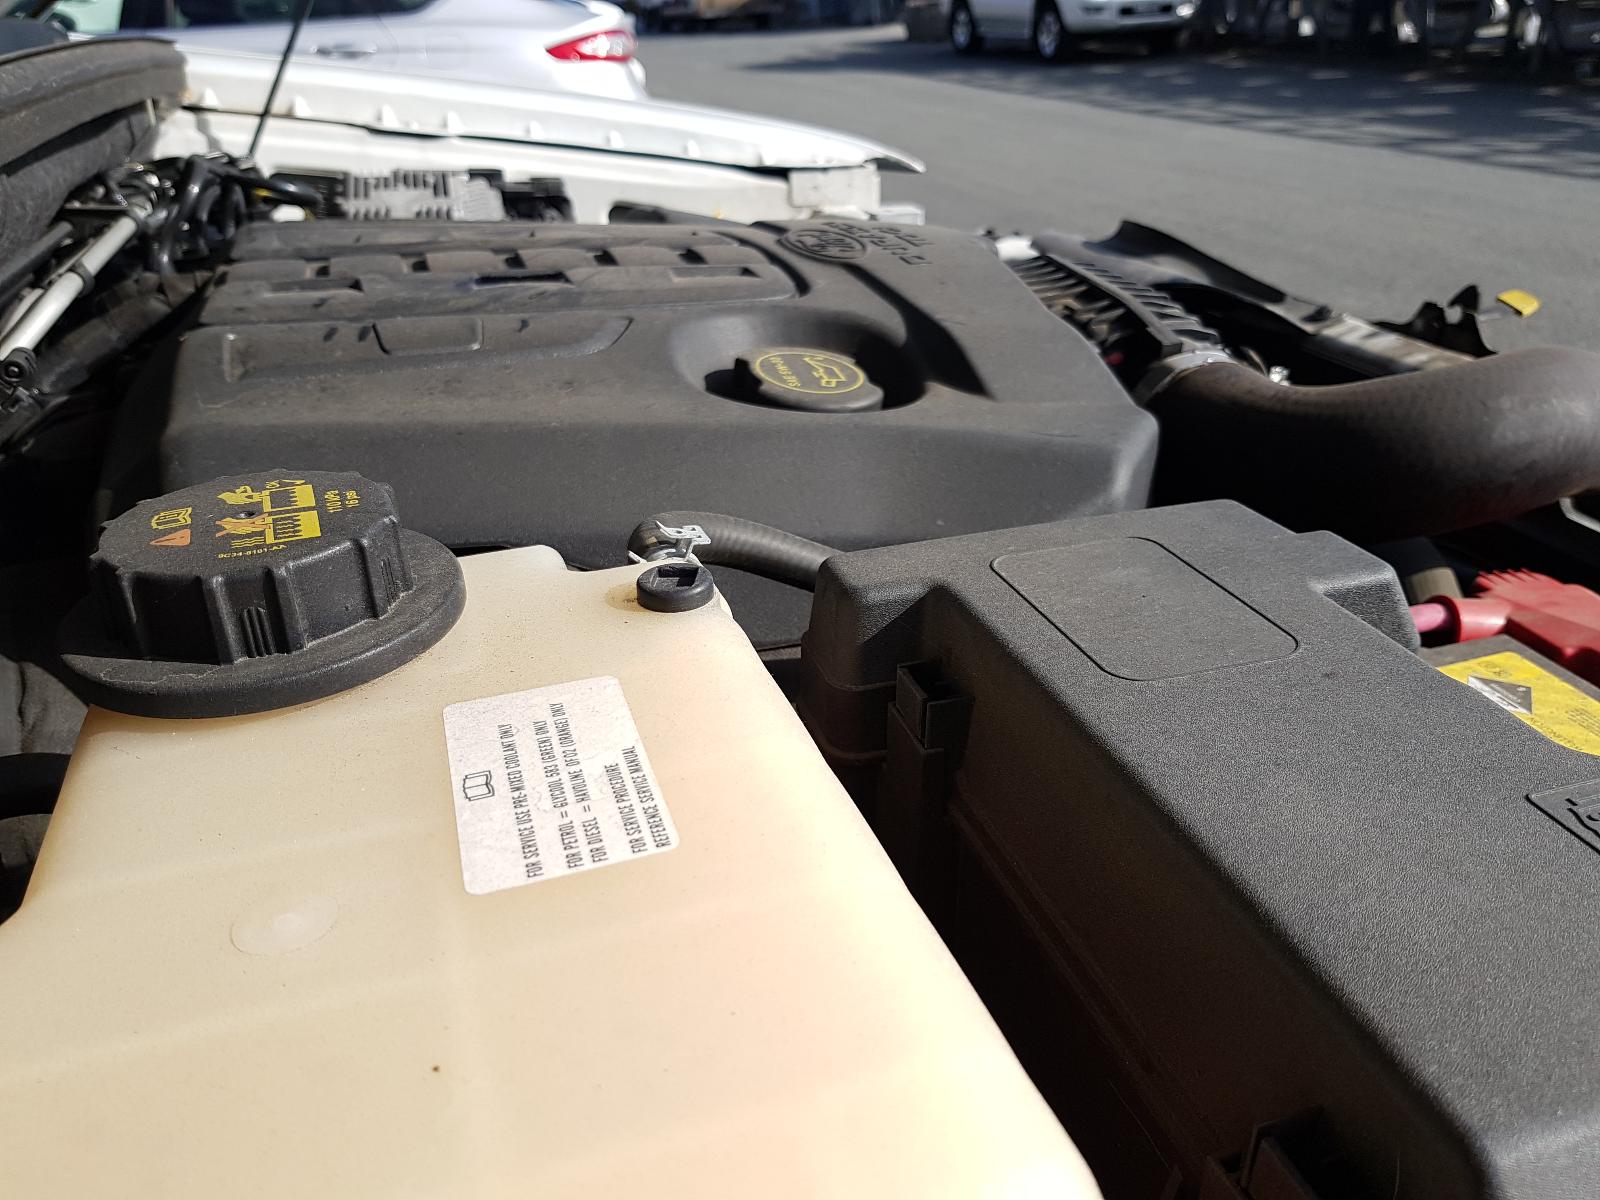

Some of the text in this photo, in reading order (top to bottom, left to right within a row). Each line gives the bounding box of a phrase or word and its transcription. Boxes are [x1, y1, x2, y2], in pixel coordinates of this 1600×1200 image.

[549, 702, 566, 718] ONLY
[554, 717, 576, 747] (ORANGE)
[497, 723, 544, 878] FOR SERVICE USE PRE-MIXED COOLANT ONLY
[532, 720, 584, 869] FOR PETROL = GLYCOOL 583 (GREEN) ONLY
[568, 768, 592, 804] HAVOLINE
[621, 745, 672, 848] REFERENCE SERVICE MANUAL
[583, 804, 591, 813] =
[604, 763, 648, 854] FOR SERVICE PROCEDURE
[581, 816, 604, 846] DIESEL
[589, 845, 609, 863] FOR
